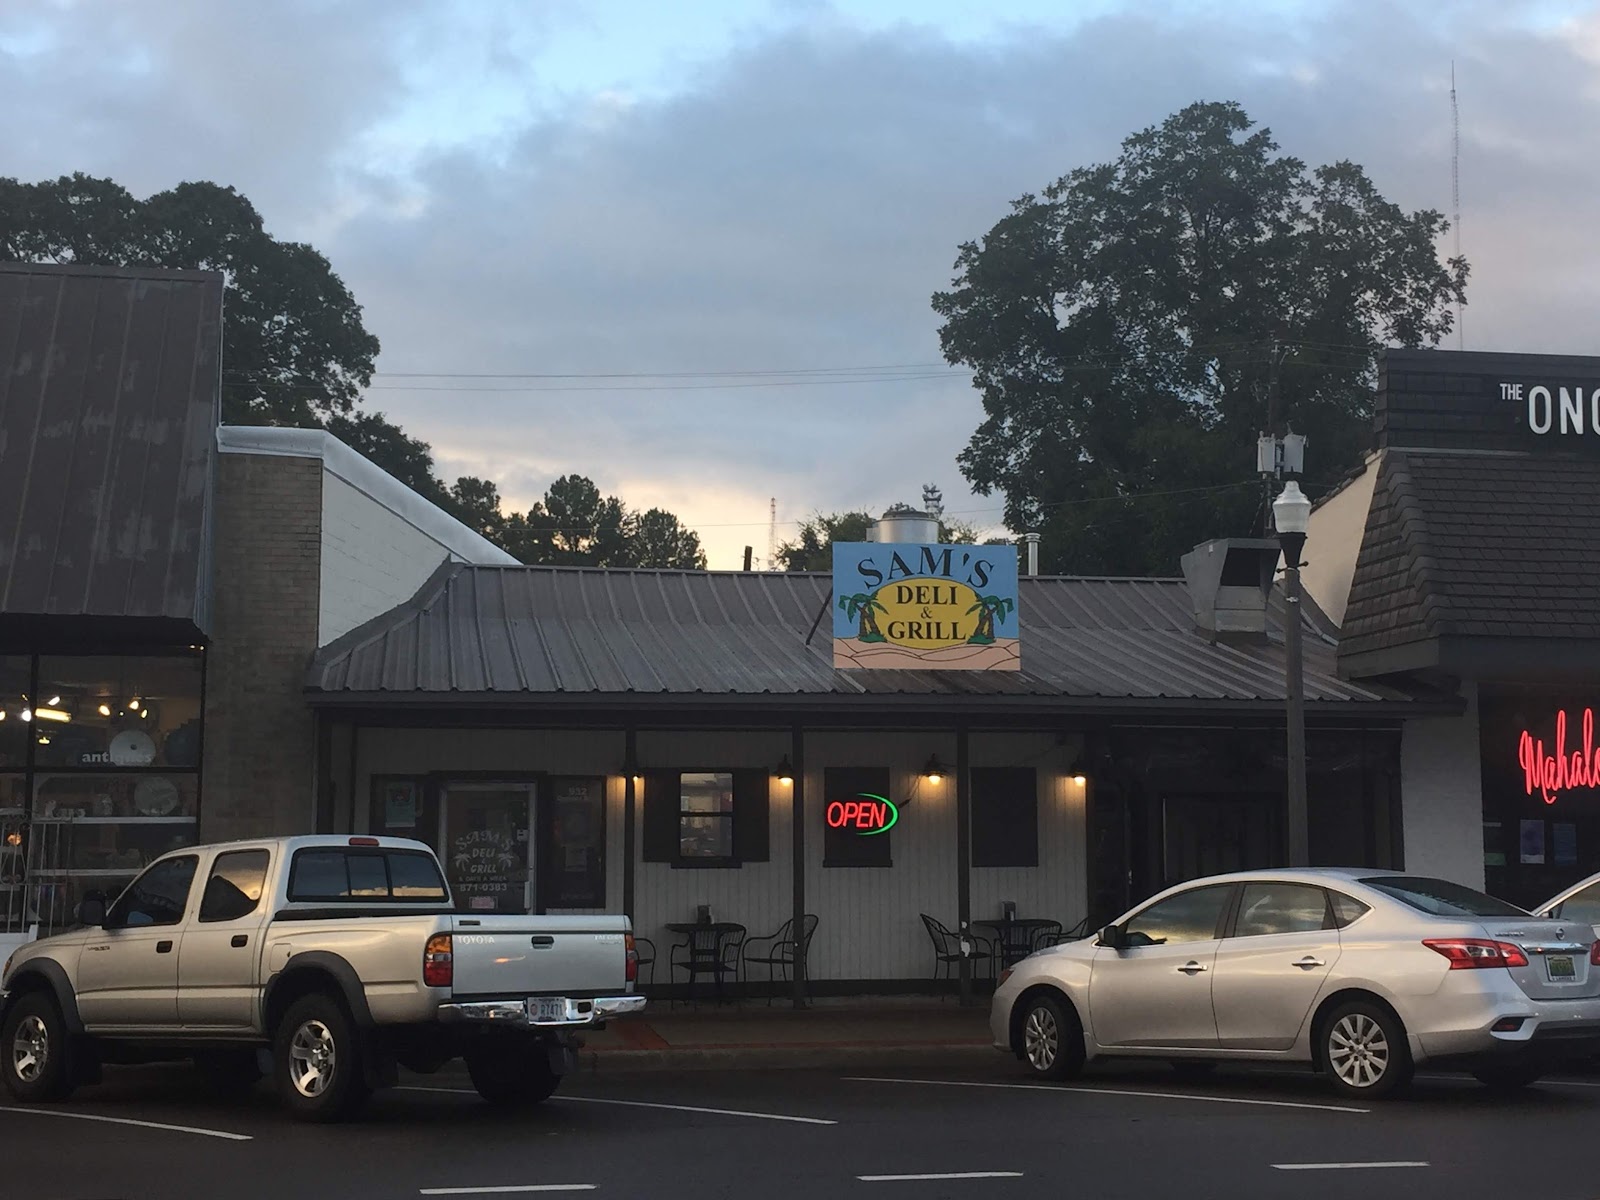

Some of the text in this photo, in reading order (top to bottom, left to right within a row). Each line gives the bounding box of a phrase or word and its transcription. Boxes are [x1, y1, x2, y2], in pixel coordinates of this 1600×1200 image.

[1500, 383, 1523, 401] THE
[857, 546, 995, 590] SAM'S
[896, 585, 958, 606] DELI
[920, 606, 933, 619] &
[887, 620, 967, 640] GRILL
[827, 801, 887, 828] OPEN
[472, 848, 496, 859] DELI
[470, 864, 498, 874] GRILL
[457, 935, 496, 945] TOYOTA
